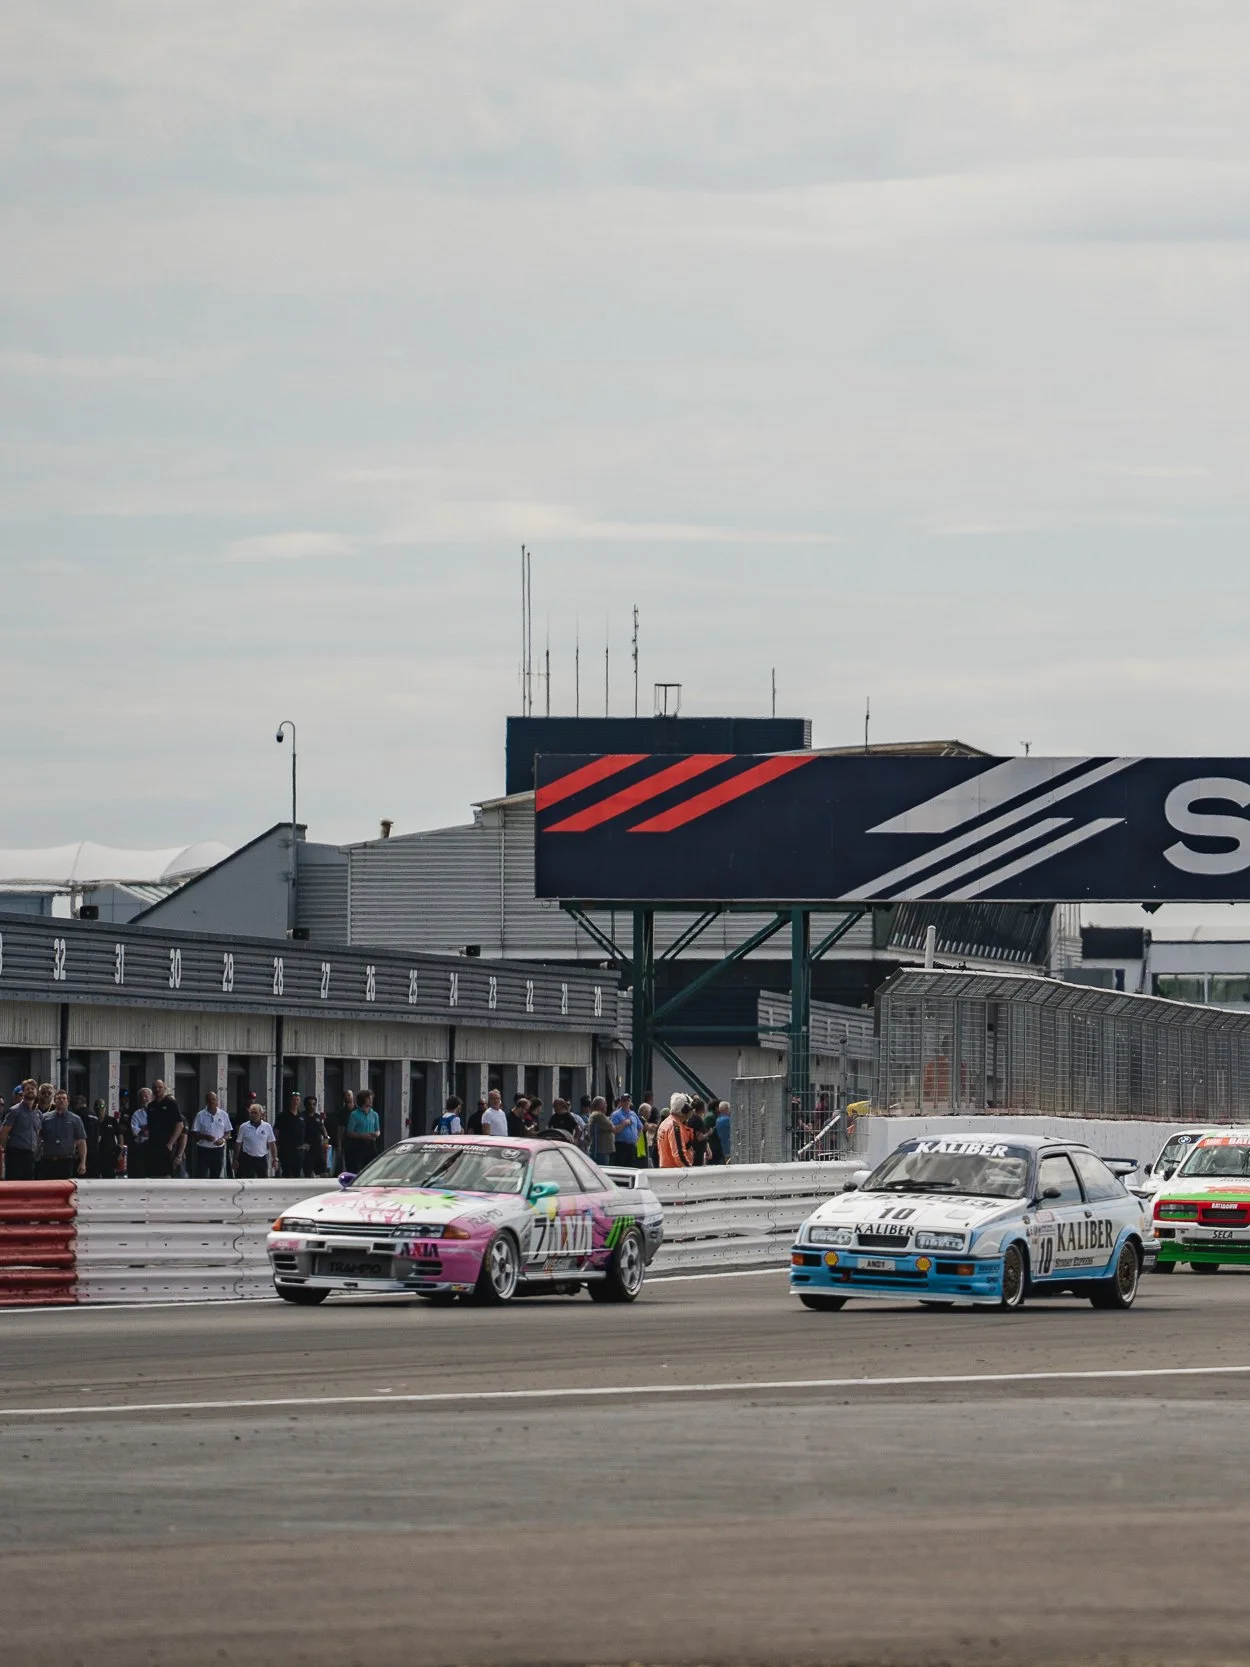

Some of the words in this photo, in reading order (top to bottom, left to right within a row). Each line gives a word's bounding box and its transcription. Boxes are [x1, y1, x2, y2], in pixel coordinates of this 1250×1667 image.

[53, 938, 67, 981] 32
[114, 943, 125, 985] 31
[168, 948, 182, 989] 30
[222, 952, 234, 992] 29
[273, 957, 284, 996] 28
[320, 961, 331, 999] 27
[366, 965, 376, 1002] 26
[409, 969, 418, 1004] 25
[450, 972, 459, 1007] 24
[488, 976, 497, 1009] 23
[526, 979, 534, 1012] 22
[561, 982, 569, 1015] 21
[594, 985, 602, 1017] 20
[422, 1143, 492, 1153] MIDDLEHURST
[912, 1142, 1008, 1158] KALIBER
[854, 1224, 915, 1236] KALIBER
[878, 1207, 918, 1220] 10
[400, 1242, 439, 1258] AXIA
[1057, 1219, 1114, 1252] KALIBER
[1212, 1230, 1234, 1240] SECA
[1038, 1237, 1053, 1274] 10
